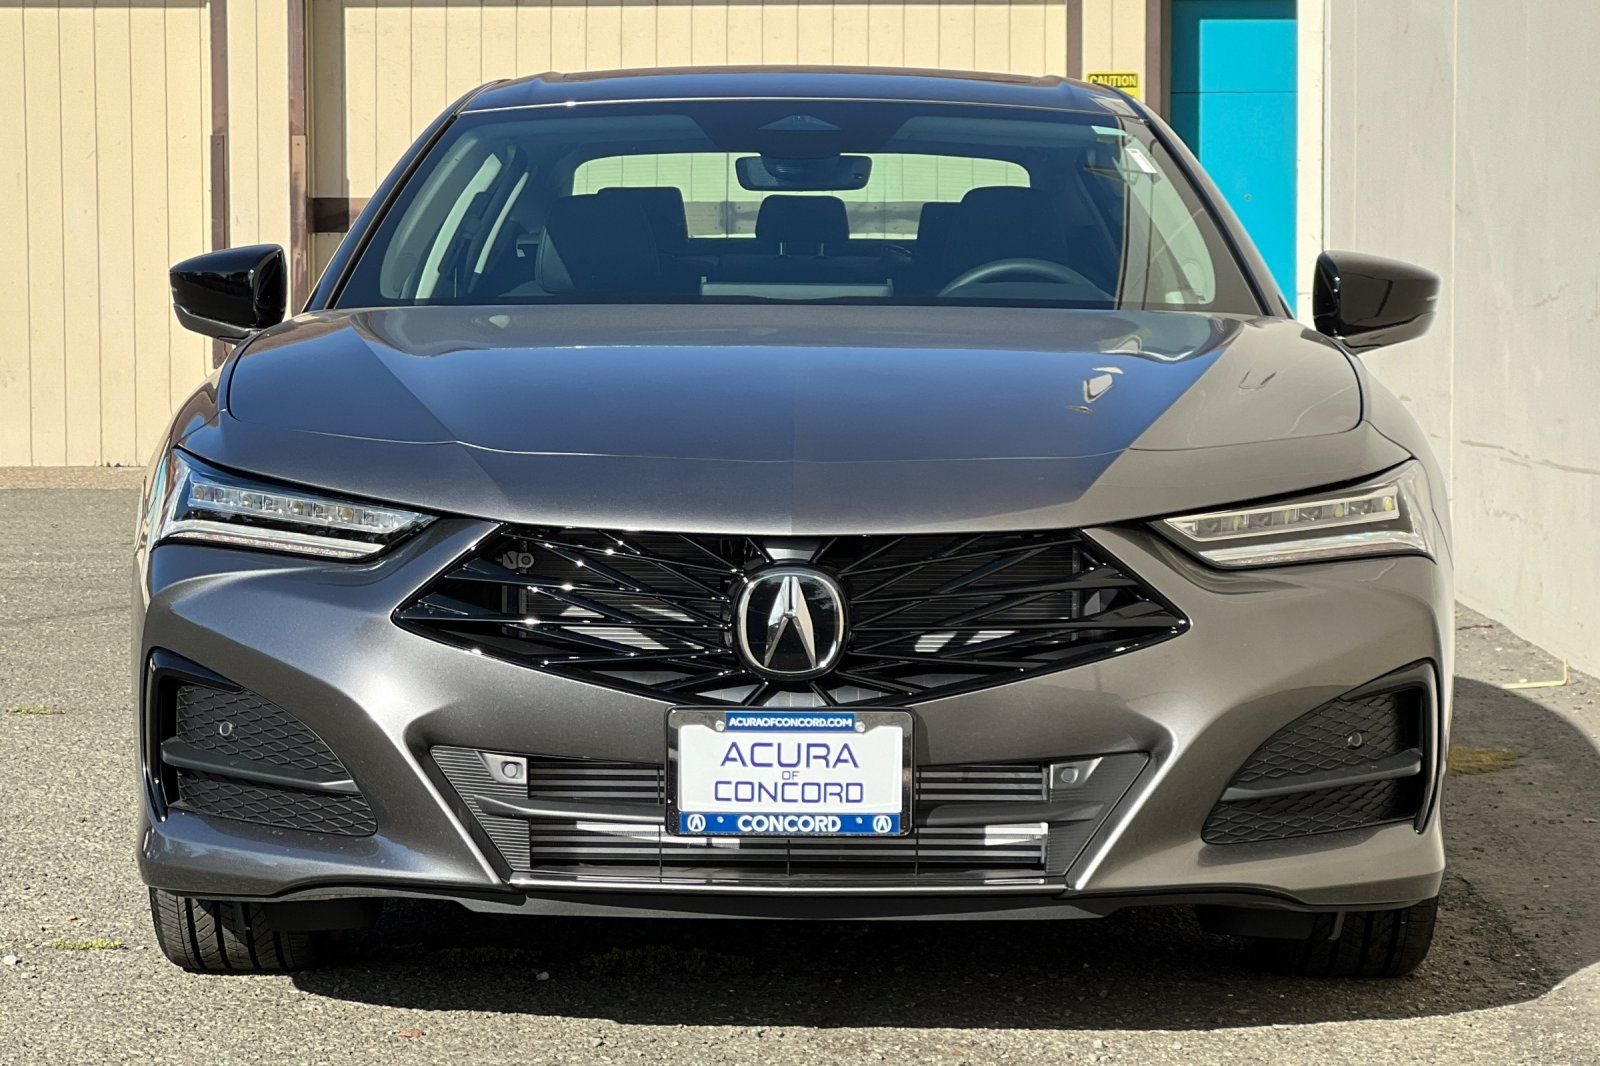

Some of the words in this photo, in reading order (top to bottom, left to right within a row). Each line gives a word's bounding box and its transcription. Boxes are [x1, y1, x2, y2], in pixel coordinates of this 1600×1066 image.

[1089, 75, 1137, 86] CAUTION
[729, 717, 852, 727] ACURAOFCONCORD.COM
[720, 741, 859, 768] ACURA
[781, 770, 799, 780] OF
[714, 780, 864, 803] CONCORD
[737, 815, 841, 832] CONCORD
